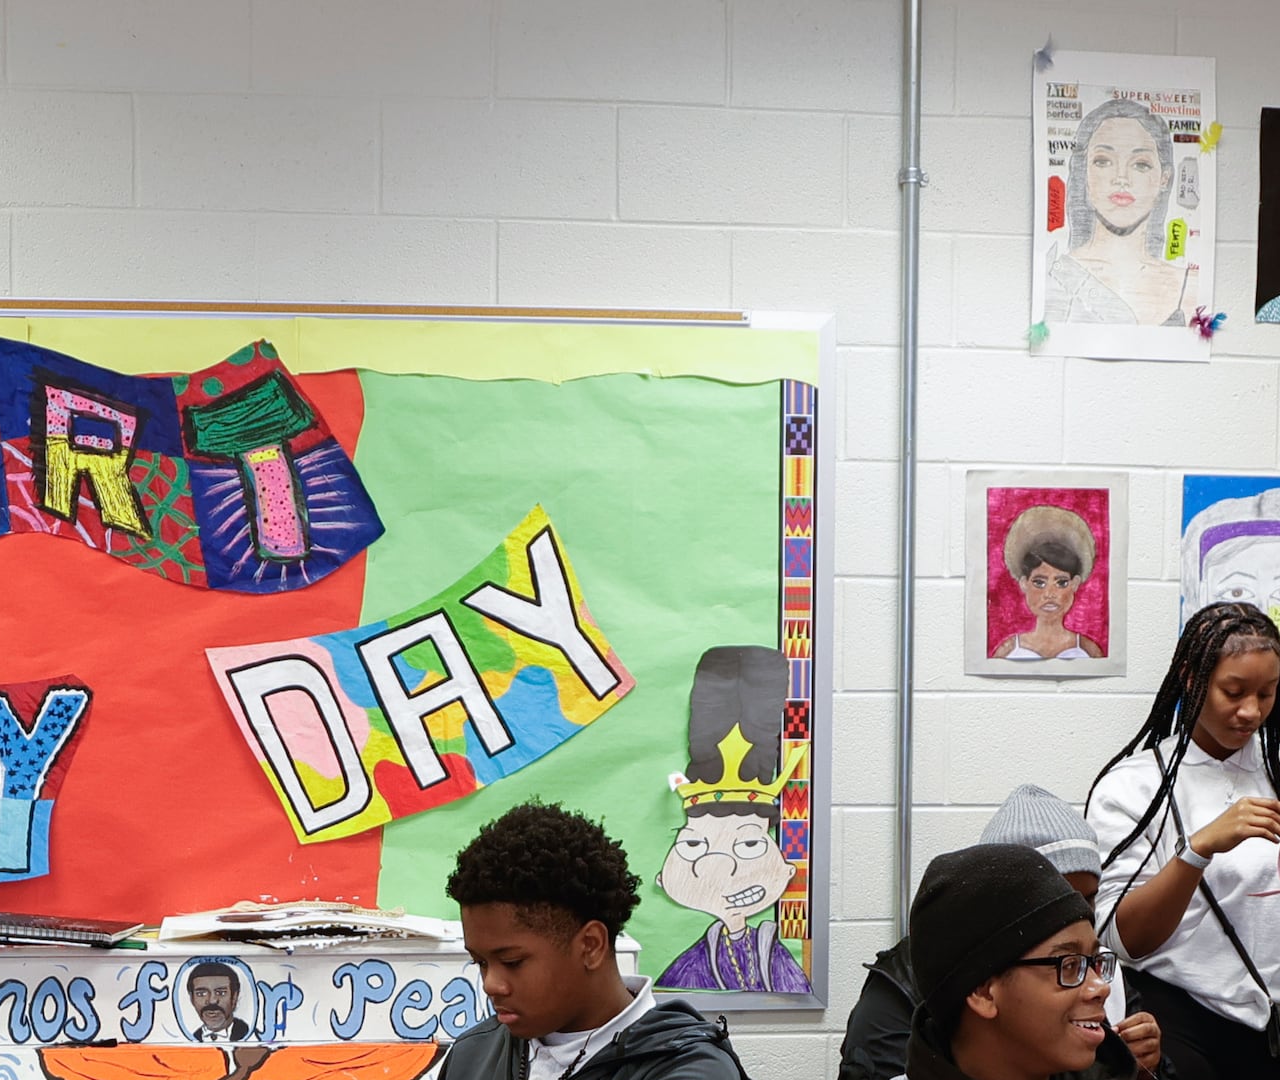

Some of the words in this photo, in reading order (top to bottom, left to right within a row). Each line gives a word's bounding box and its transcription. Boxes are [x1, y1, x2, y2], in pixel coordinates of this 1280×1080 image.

[1113, 90, 1150, 101] SUPER
[1156, 92, 1194, 103] SWEET
[224, 522, 623, 835] DAY
